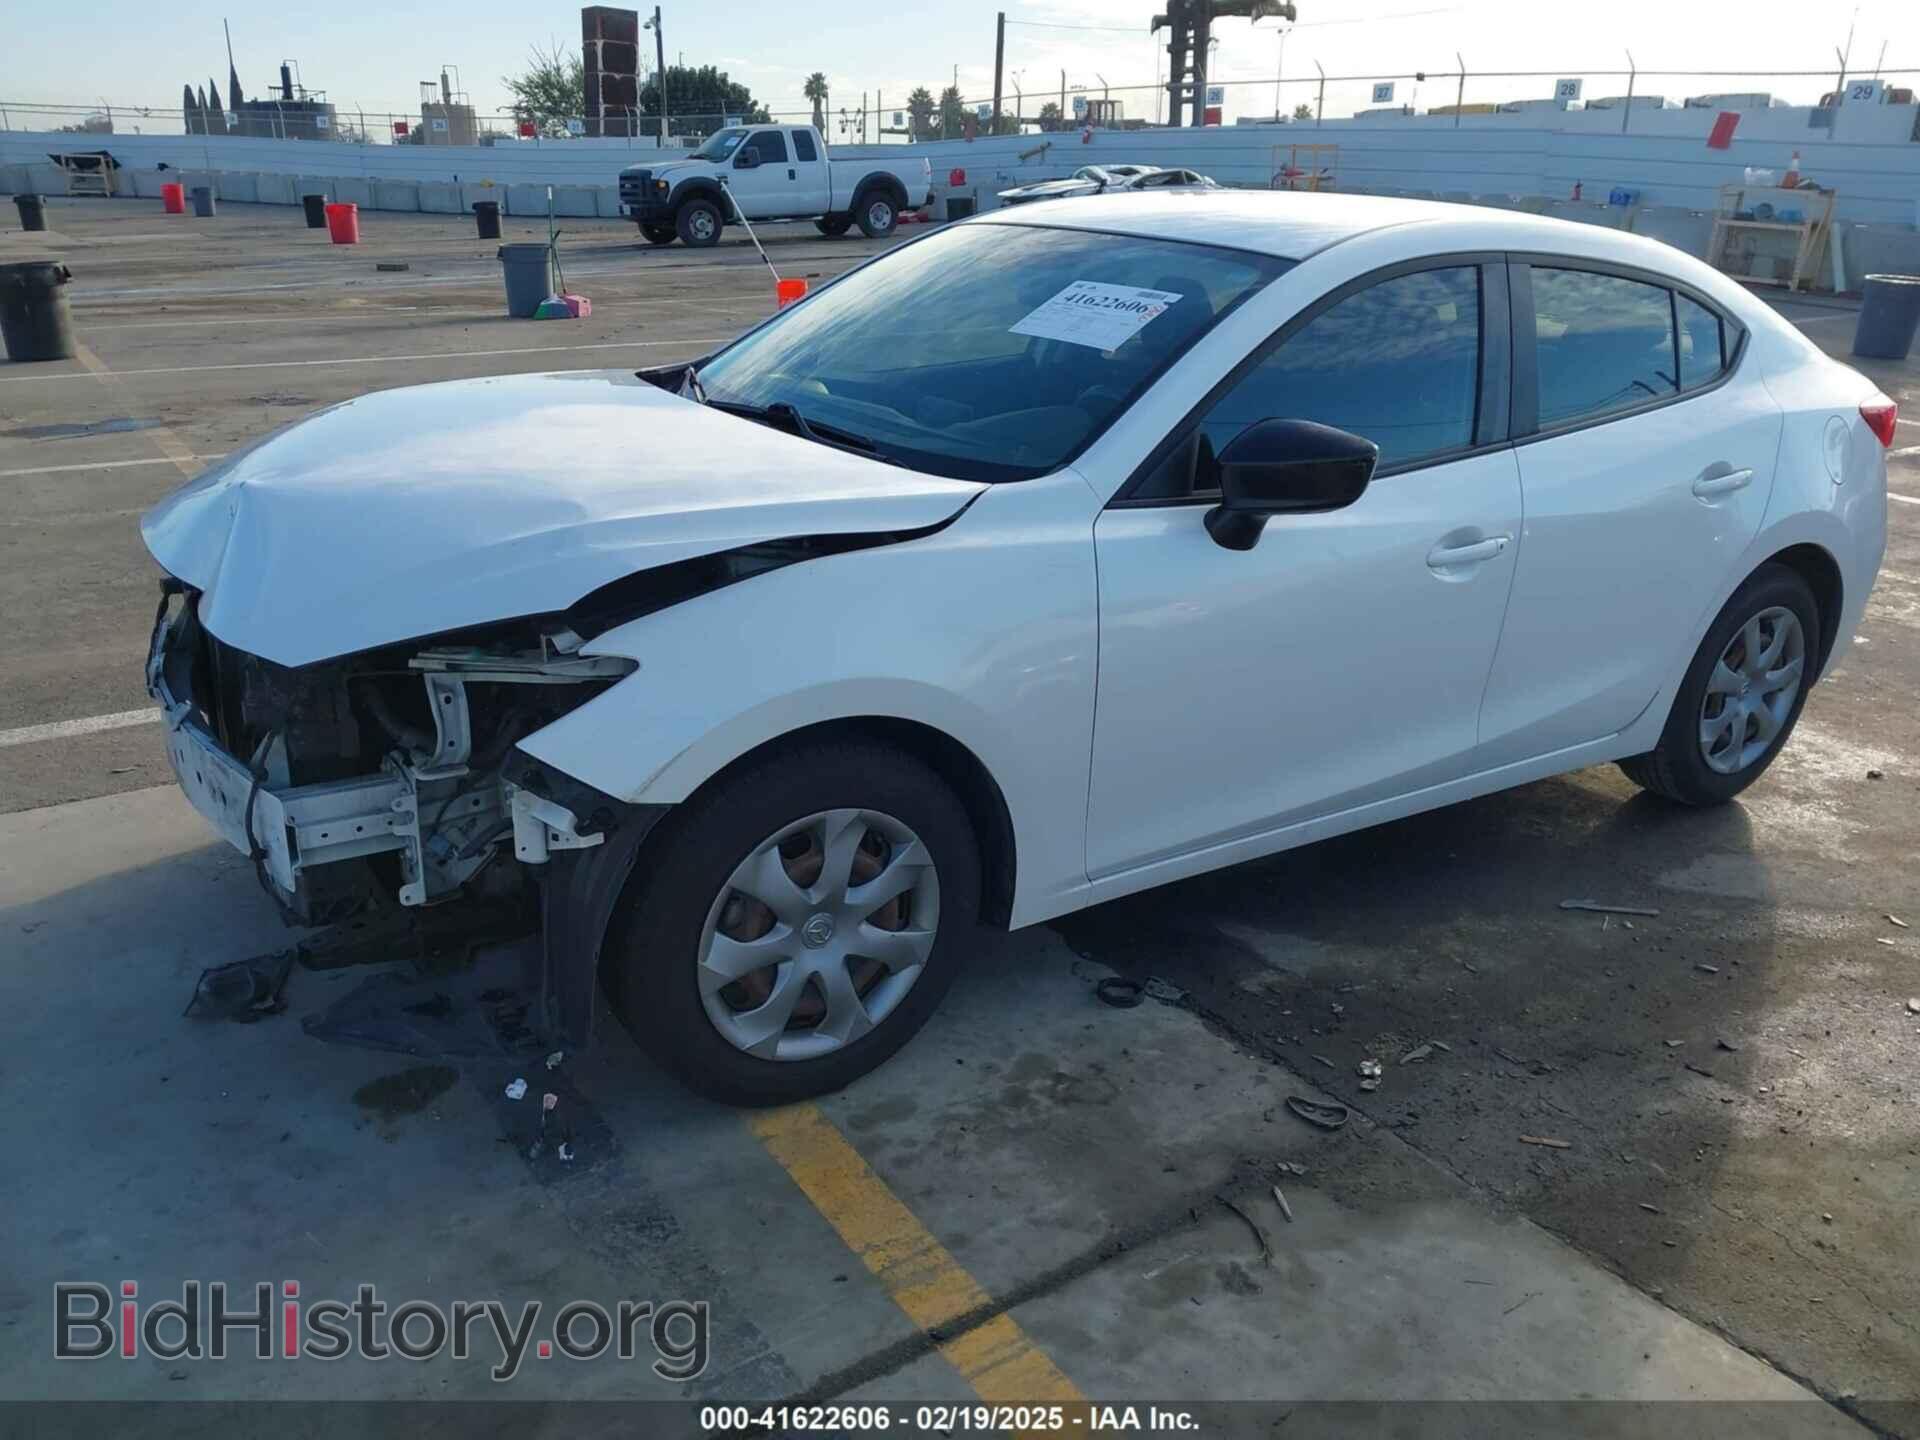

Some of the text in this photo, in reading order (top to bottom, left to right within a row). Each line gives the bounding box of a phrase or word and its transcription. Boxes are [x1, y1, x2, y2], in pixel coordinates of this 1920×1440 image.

[1377, 87, 1390, 98] 27
[1560, 83, 1577, 97] 28
[1853, 85, 1873, 100] 29
[1063, 291, 1149, 313] 41622606
